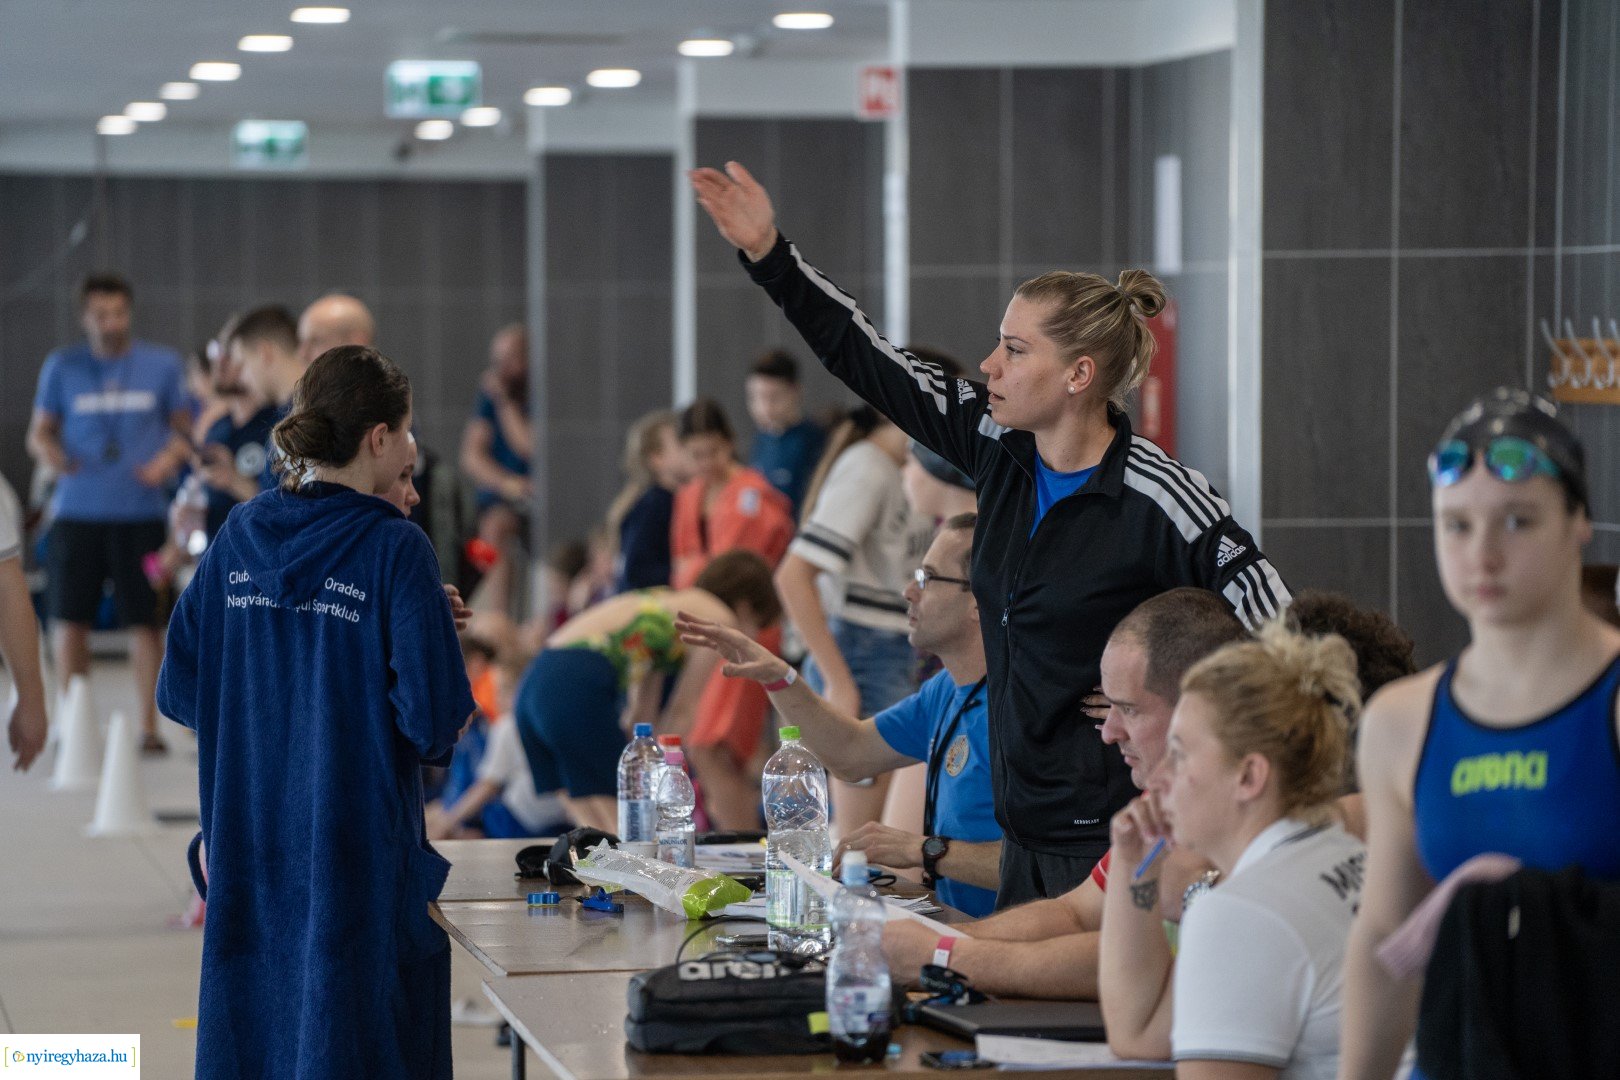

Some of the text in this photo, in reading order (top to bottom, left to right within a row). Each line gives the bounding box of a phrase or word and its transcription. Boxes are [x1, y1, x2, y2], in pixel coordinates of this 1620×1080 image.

[1217, 545, 1247, 567] adidas
[229, 570, 366, 601] Club Oradea
[1450, 750, 1548, 797] arena
